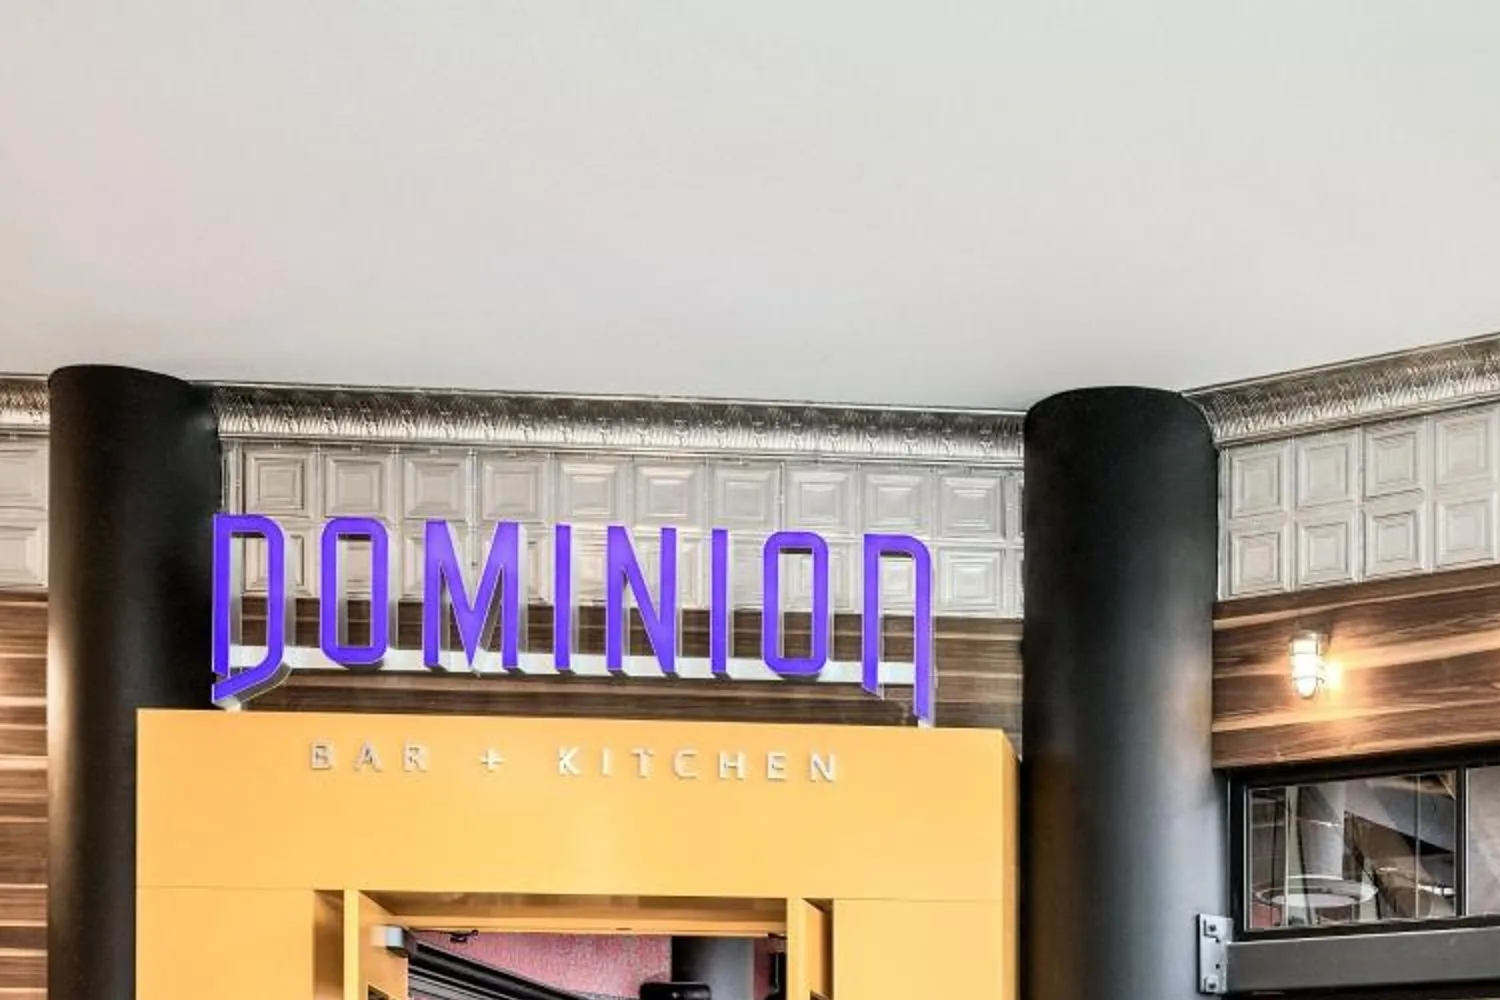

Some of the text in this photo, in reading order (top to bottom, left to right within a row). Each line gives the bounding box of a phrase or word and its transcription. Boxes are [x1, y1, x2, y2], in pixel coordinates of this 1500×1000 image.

[212, 514, 934, 723] DOMINION
[310, 740, 837, 782] BAR + KITCHEN
